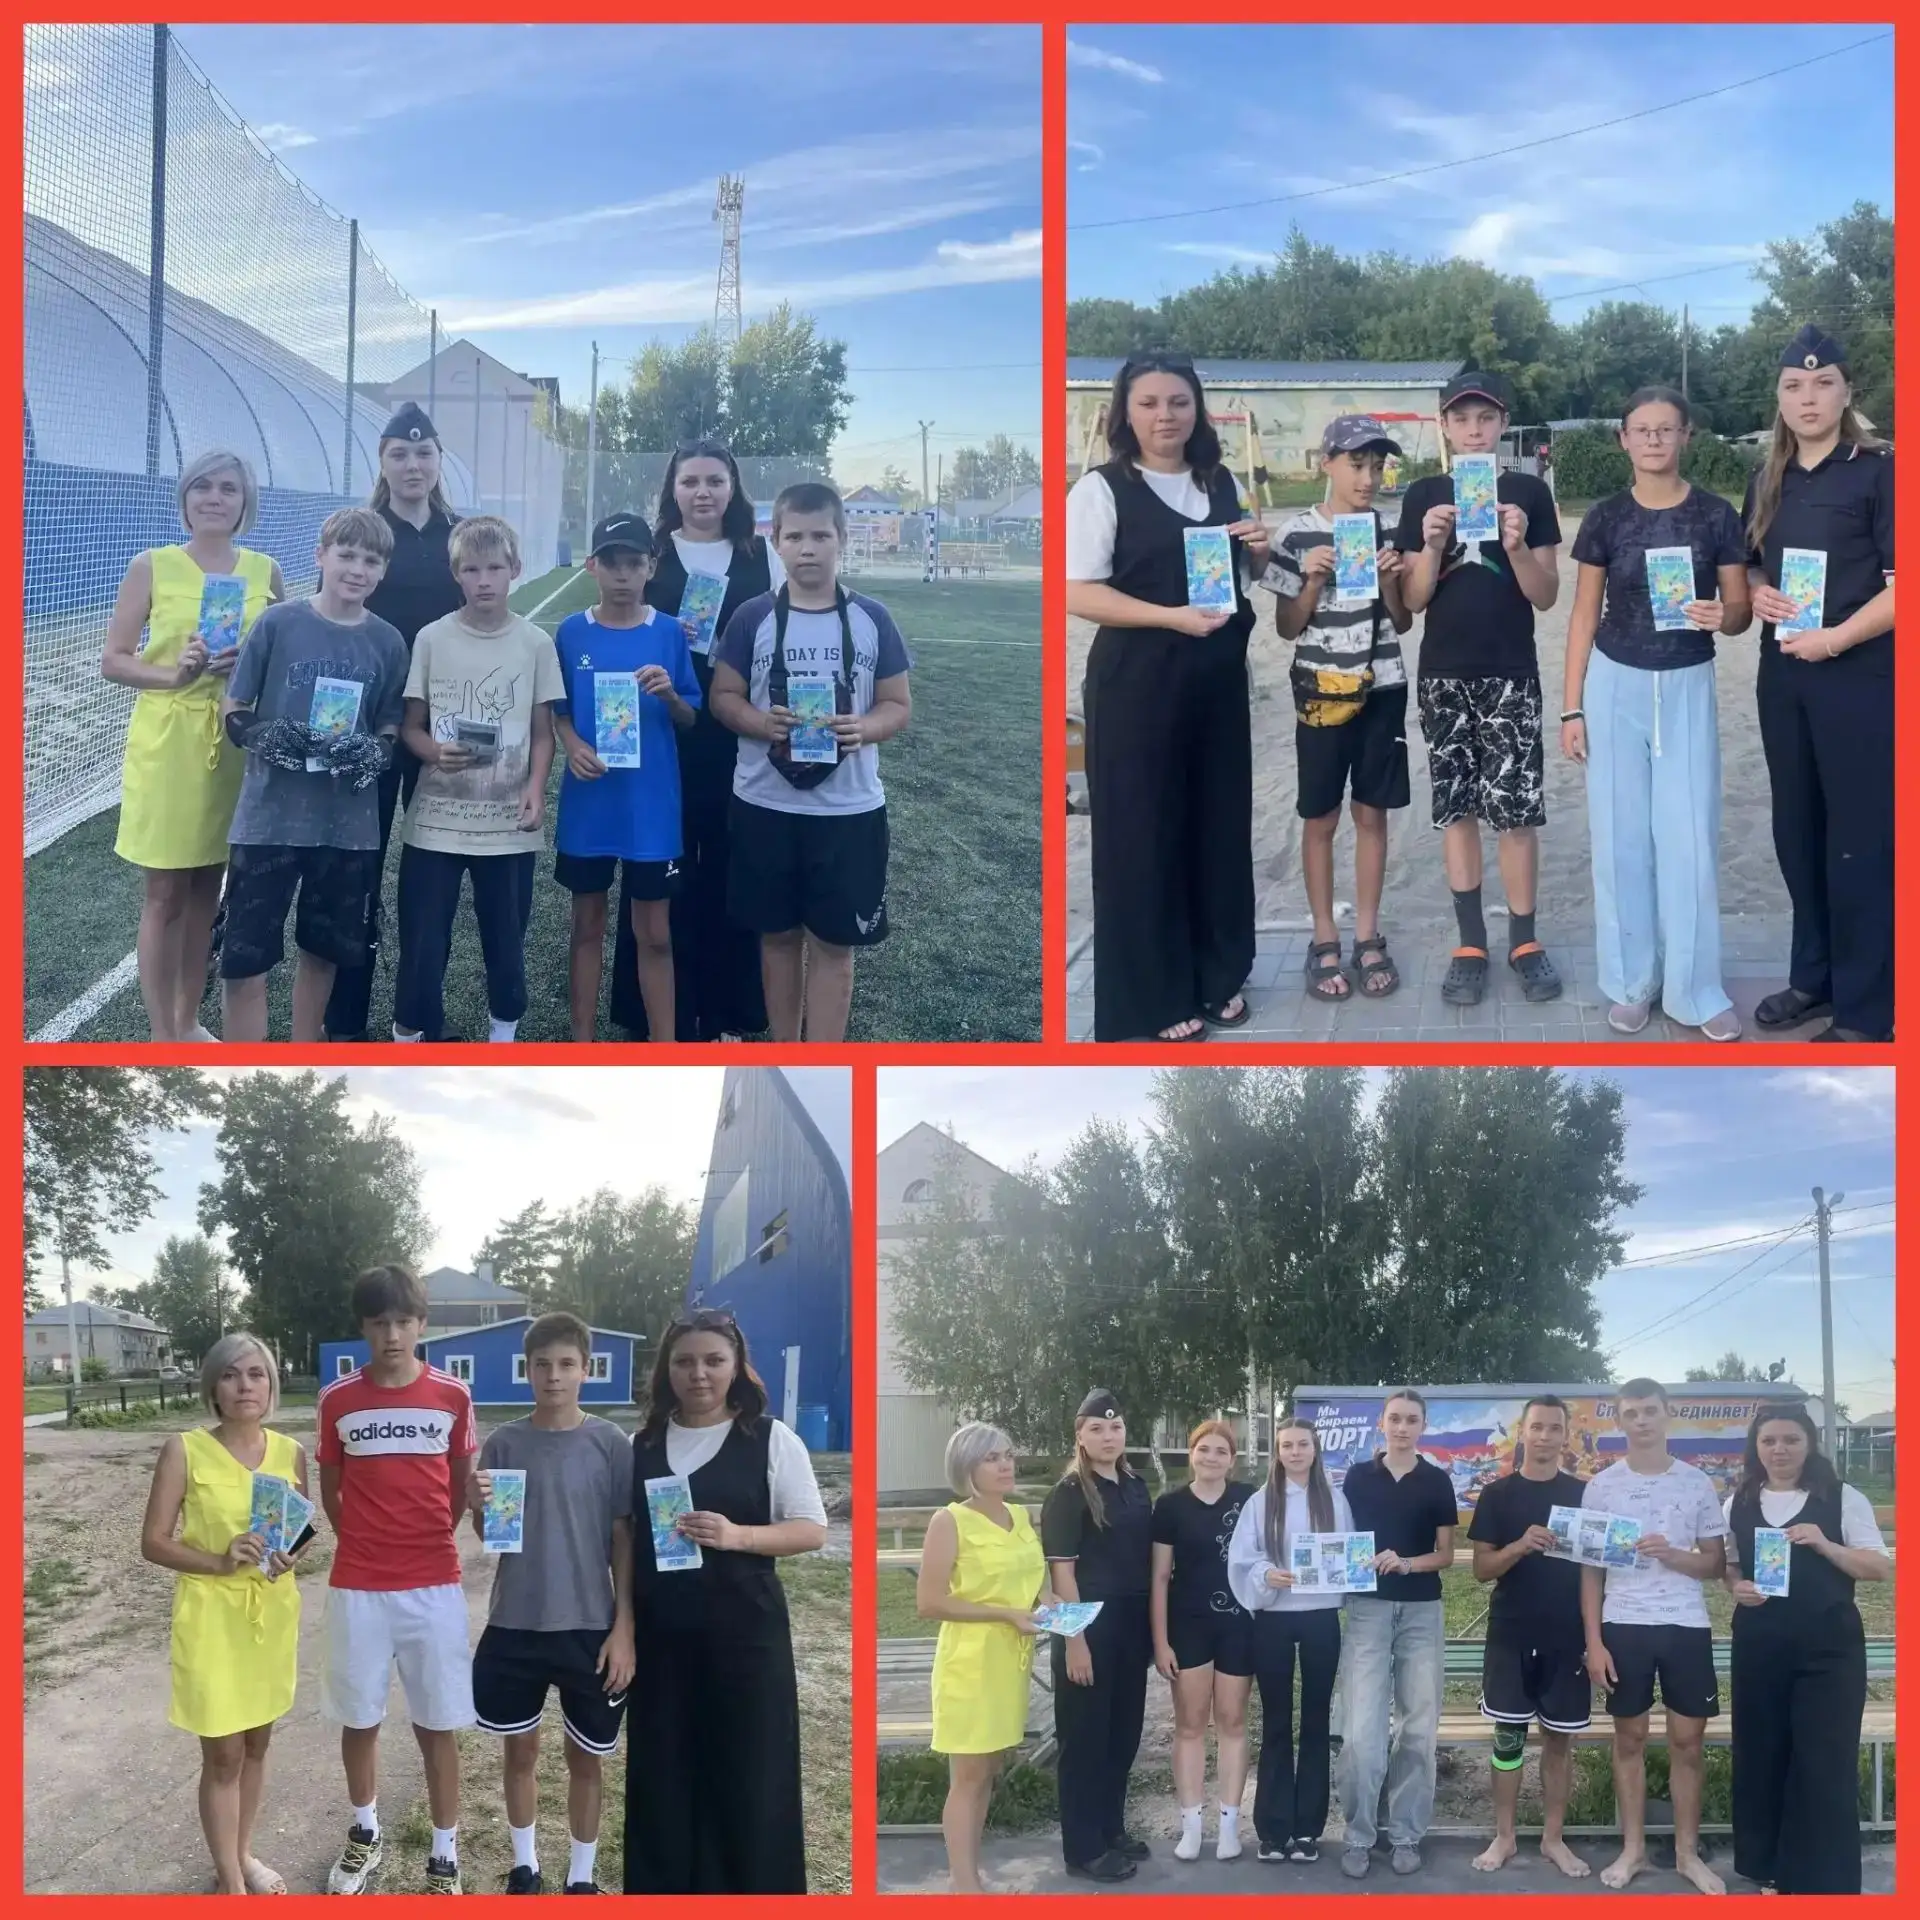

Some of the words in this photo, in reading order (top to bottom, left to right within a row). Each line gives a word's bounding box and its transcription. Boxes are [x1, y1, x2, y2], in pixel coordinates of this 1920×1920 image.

[754, 653, 774, 671] TH
[786, 648, 817, 661] DAY
[824, 648, 840, 660] IS
[1317, 1405, 1340, 1417] Мы
[350, 1421, 417, 1442] adidas
[1315, 1416, 1368, 1428] бираем
[1317, 1427, 1372, 1452] ПОРТ
